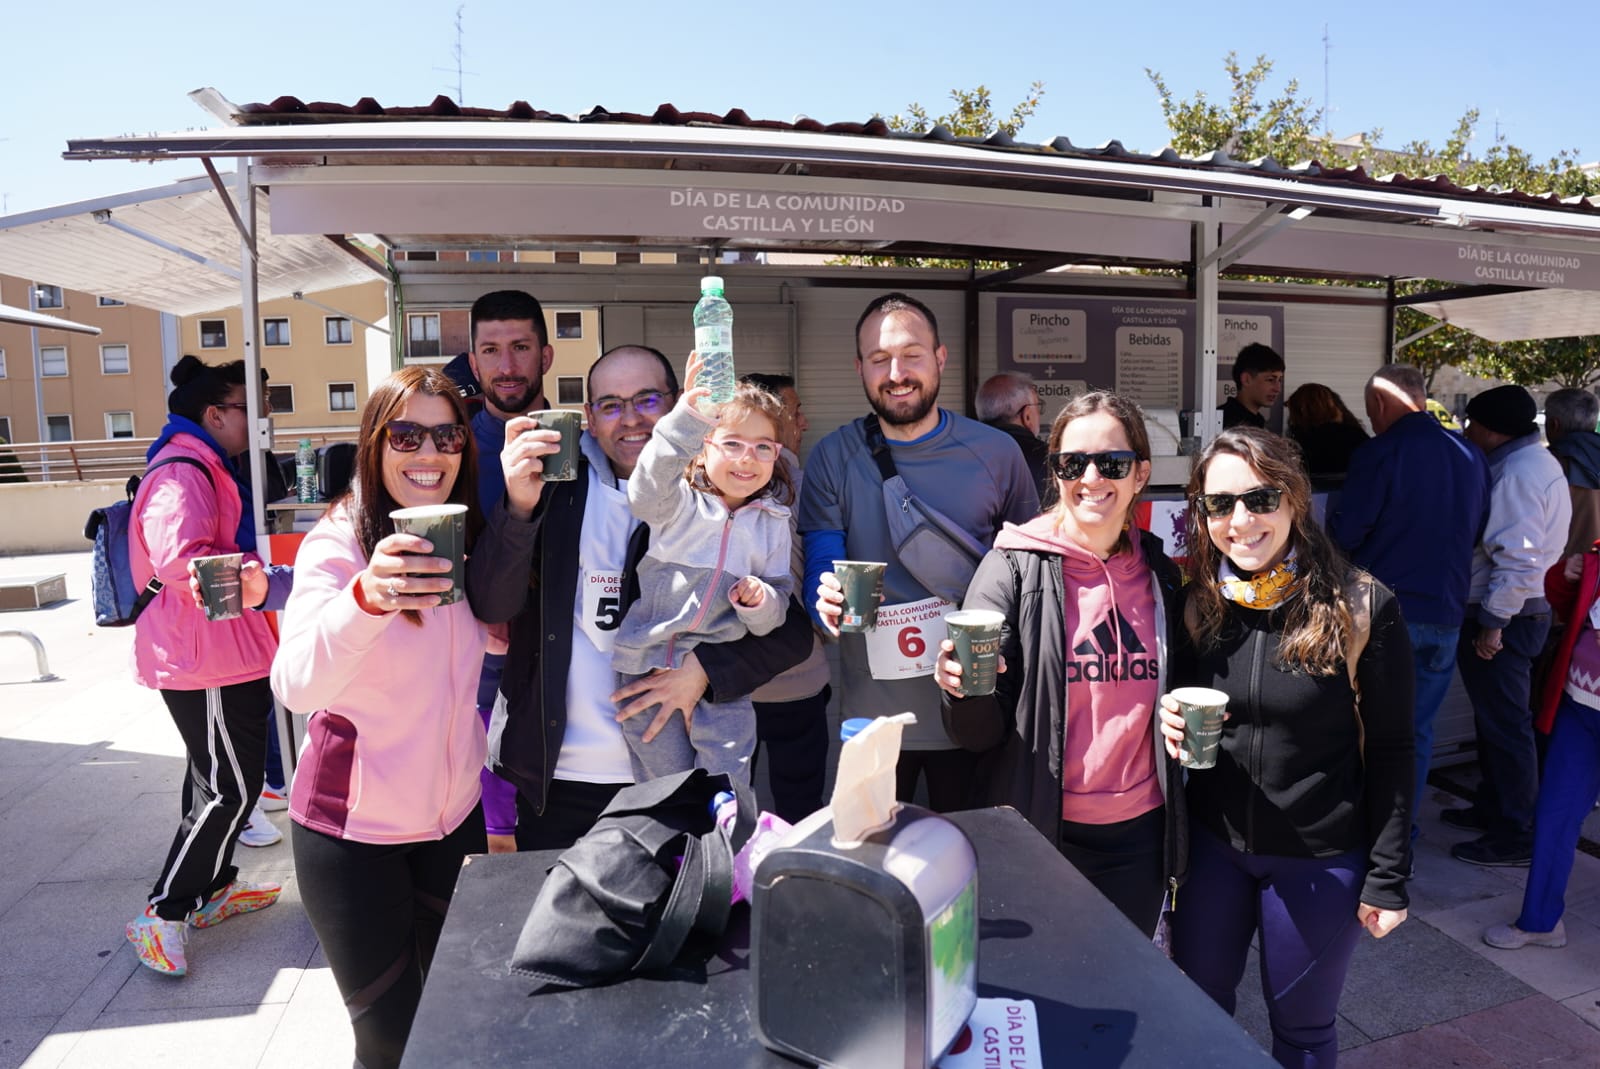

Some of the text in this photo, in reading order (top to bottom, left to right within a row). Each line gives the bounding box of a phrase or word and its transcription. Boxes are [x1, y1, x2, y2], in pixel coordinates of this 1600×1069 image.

[670, 188, 905, 213] DÍA DE LA COMUNIDAD
[703, 215, 875, 233] CASTILLA Y LEÓN
[1458, 245, 1580, 269] DÍA DE LA COMUNIDAD
[1475, 266, 1564, 283] CASTILLA Y LEÓN
[1030, 313, 1070, 326] Pincho
[1224, 318, 1258, 331] Pincho
[1129, 333, 1171, 346] Bebidas
[591, 575, 606, 583] DÍA
[888, 609, 899, 617] LA
[900, 600, 951, 615] COMUNIDAD
[919, 610, 941, 621] LEÓN
[898, 626, 926, 658] 6
[1067, 653, 1159, 683] adidas
[1006, 1006, 1026, 1031] DÍA
[983, 1026, 1000, 1069] CASTI
[1008, 1035, 1025, 1056] DE
